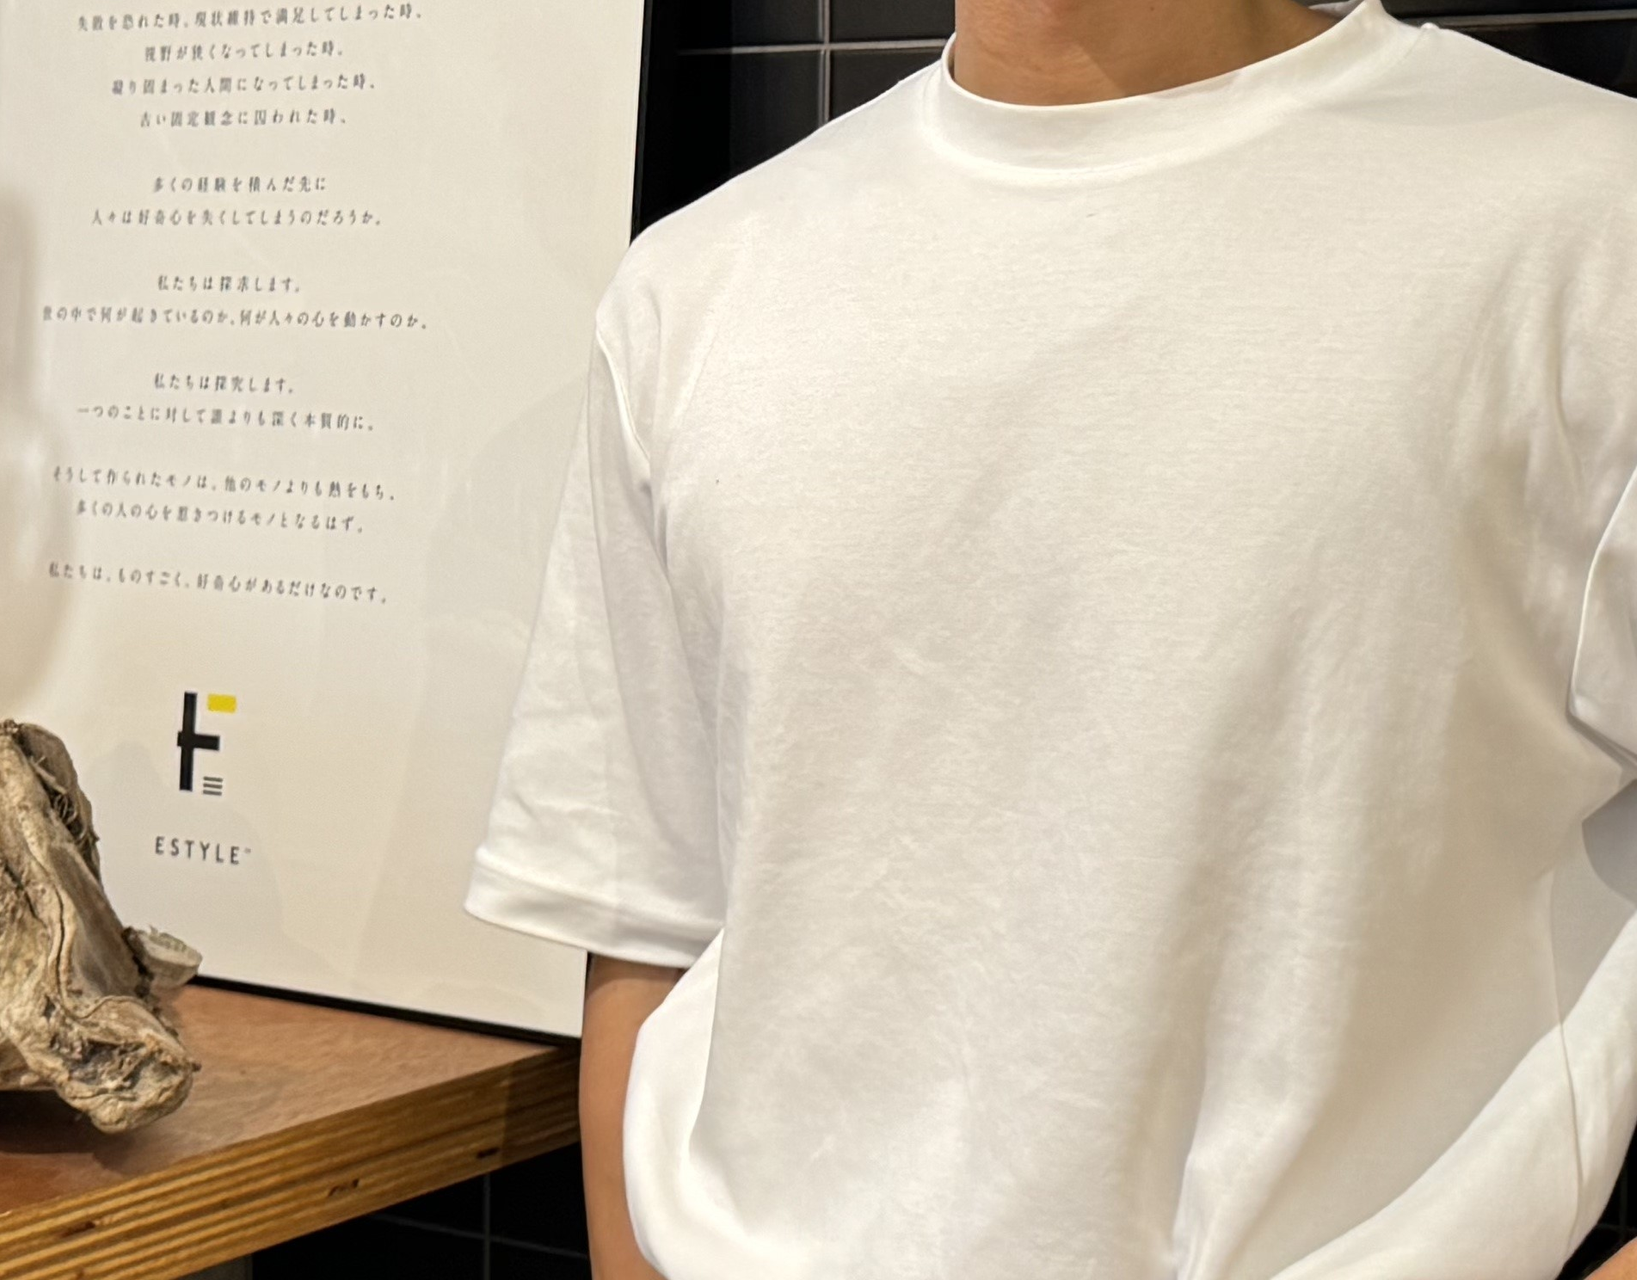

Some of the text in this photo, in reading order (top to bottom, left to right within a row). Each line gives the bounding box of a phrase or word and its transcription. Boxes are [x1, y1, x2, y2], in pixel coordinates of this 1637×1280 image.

[152, 175, 326, 194] 多くの経験を積んだ先に
